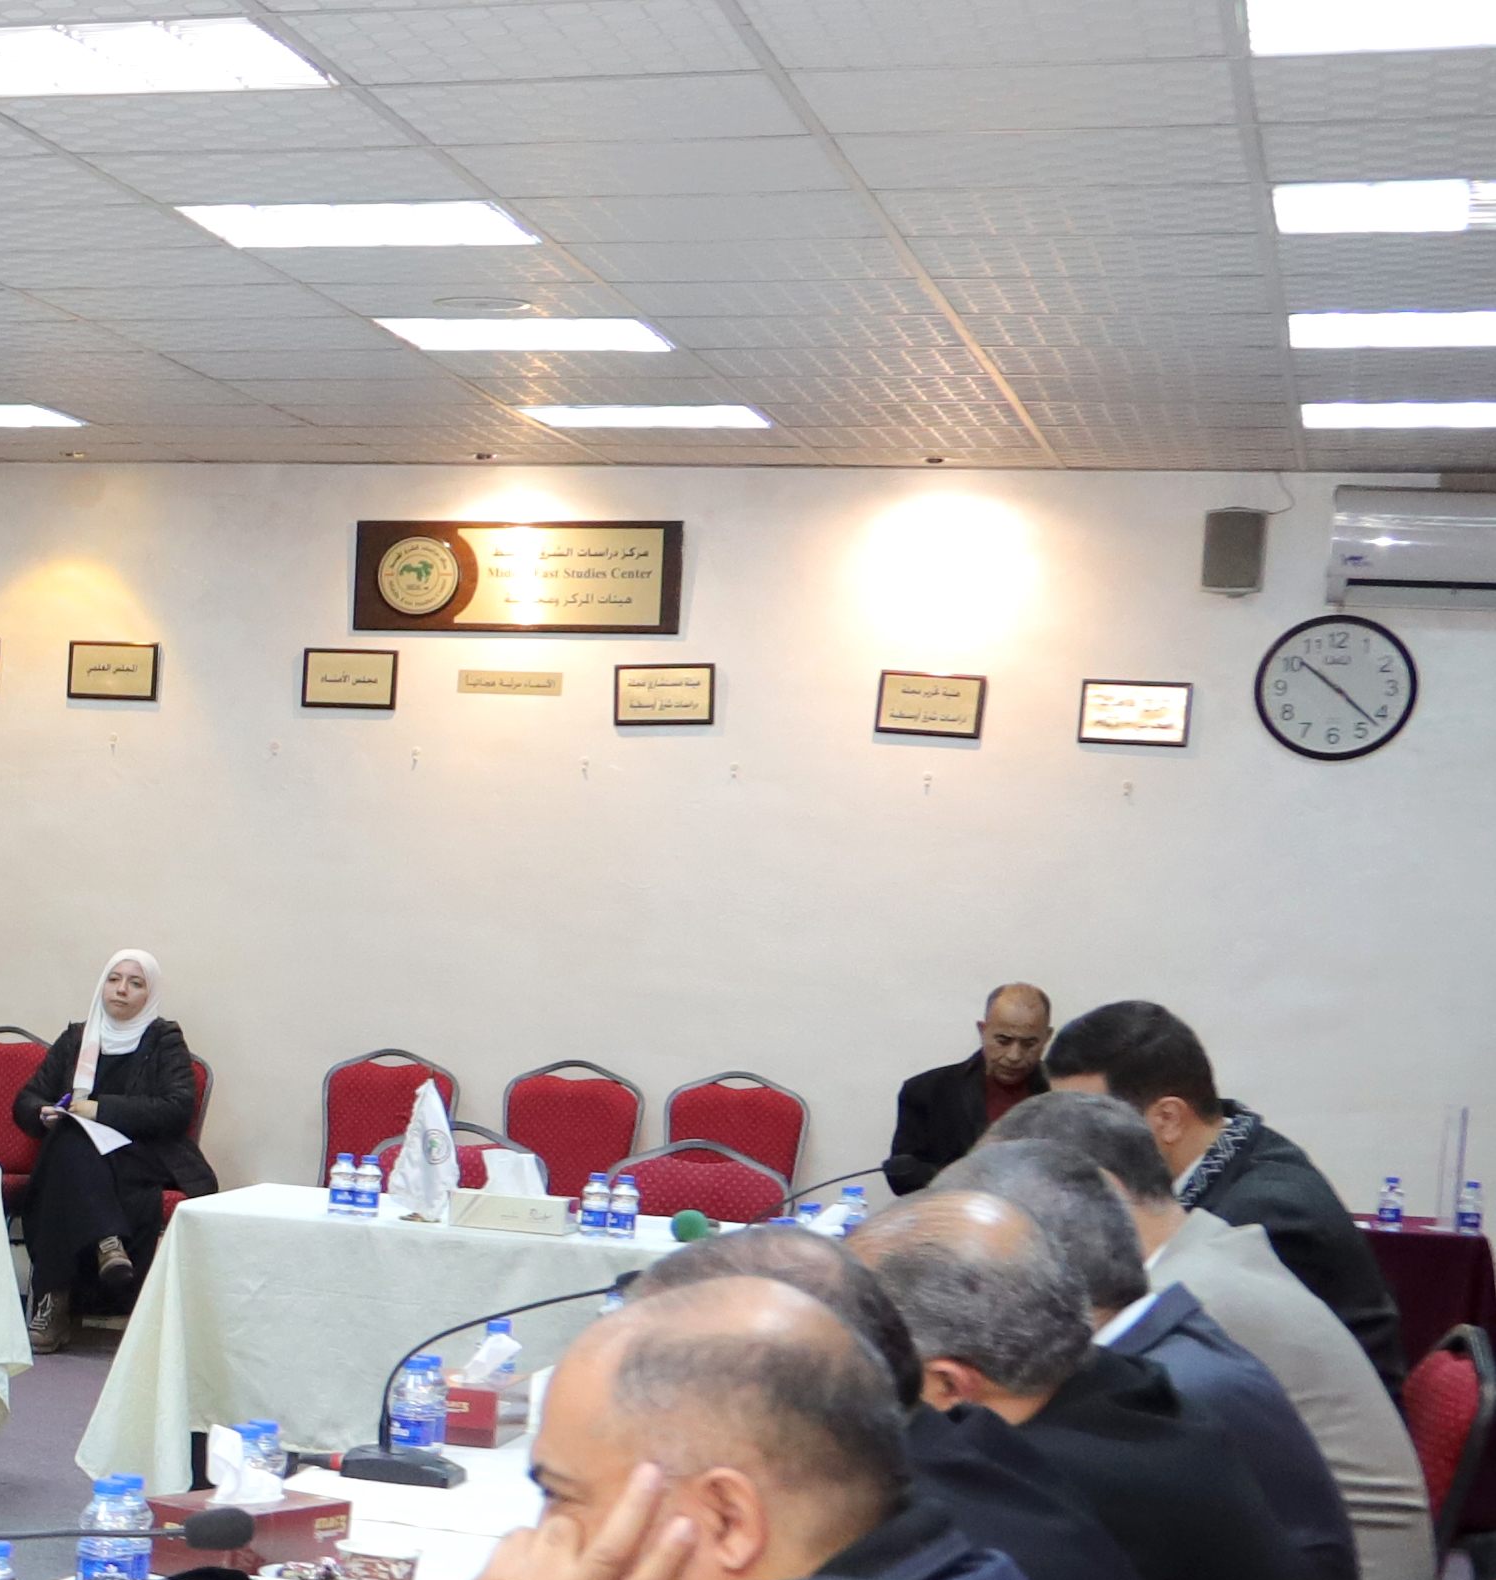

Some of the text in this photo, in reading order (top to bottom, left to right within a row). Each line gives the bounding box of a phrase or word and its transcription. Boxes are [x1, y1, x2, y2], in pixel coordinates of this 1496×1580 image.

[576, 548, 619, 560] دراسات
[620, 546, 649, 560] مركز
[564, 567, 608, 578] Studies
[610, 567, 653, 578] Center
[563, 593, 595, 608] المركز
[1303, 638, 1323, 654] 11
[1329, 631, 1350, 649] 12
[1361, 638, 1371, 654] 1
[1282, 656, 1303, 672] 10
[1377, 655, 1394, 673] 2
[1274, 679, 1288, 696] 9
[1384, 679, 1400, 697] 3
[1280, 703, 1296, 721] 8
[1375, 704, 1389, 718] 4
[1298, 722, 1313, 738] 7
[1326, 727, 1341, 745] 6
[1353, 722, 1369, 739] 5
